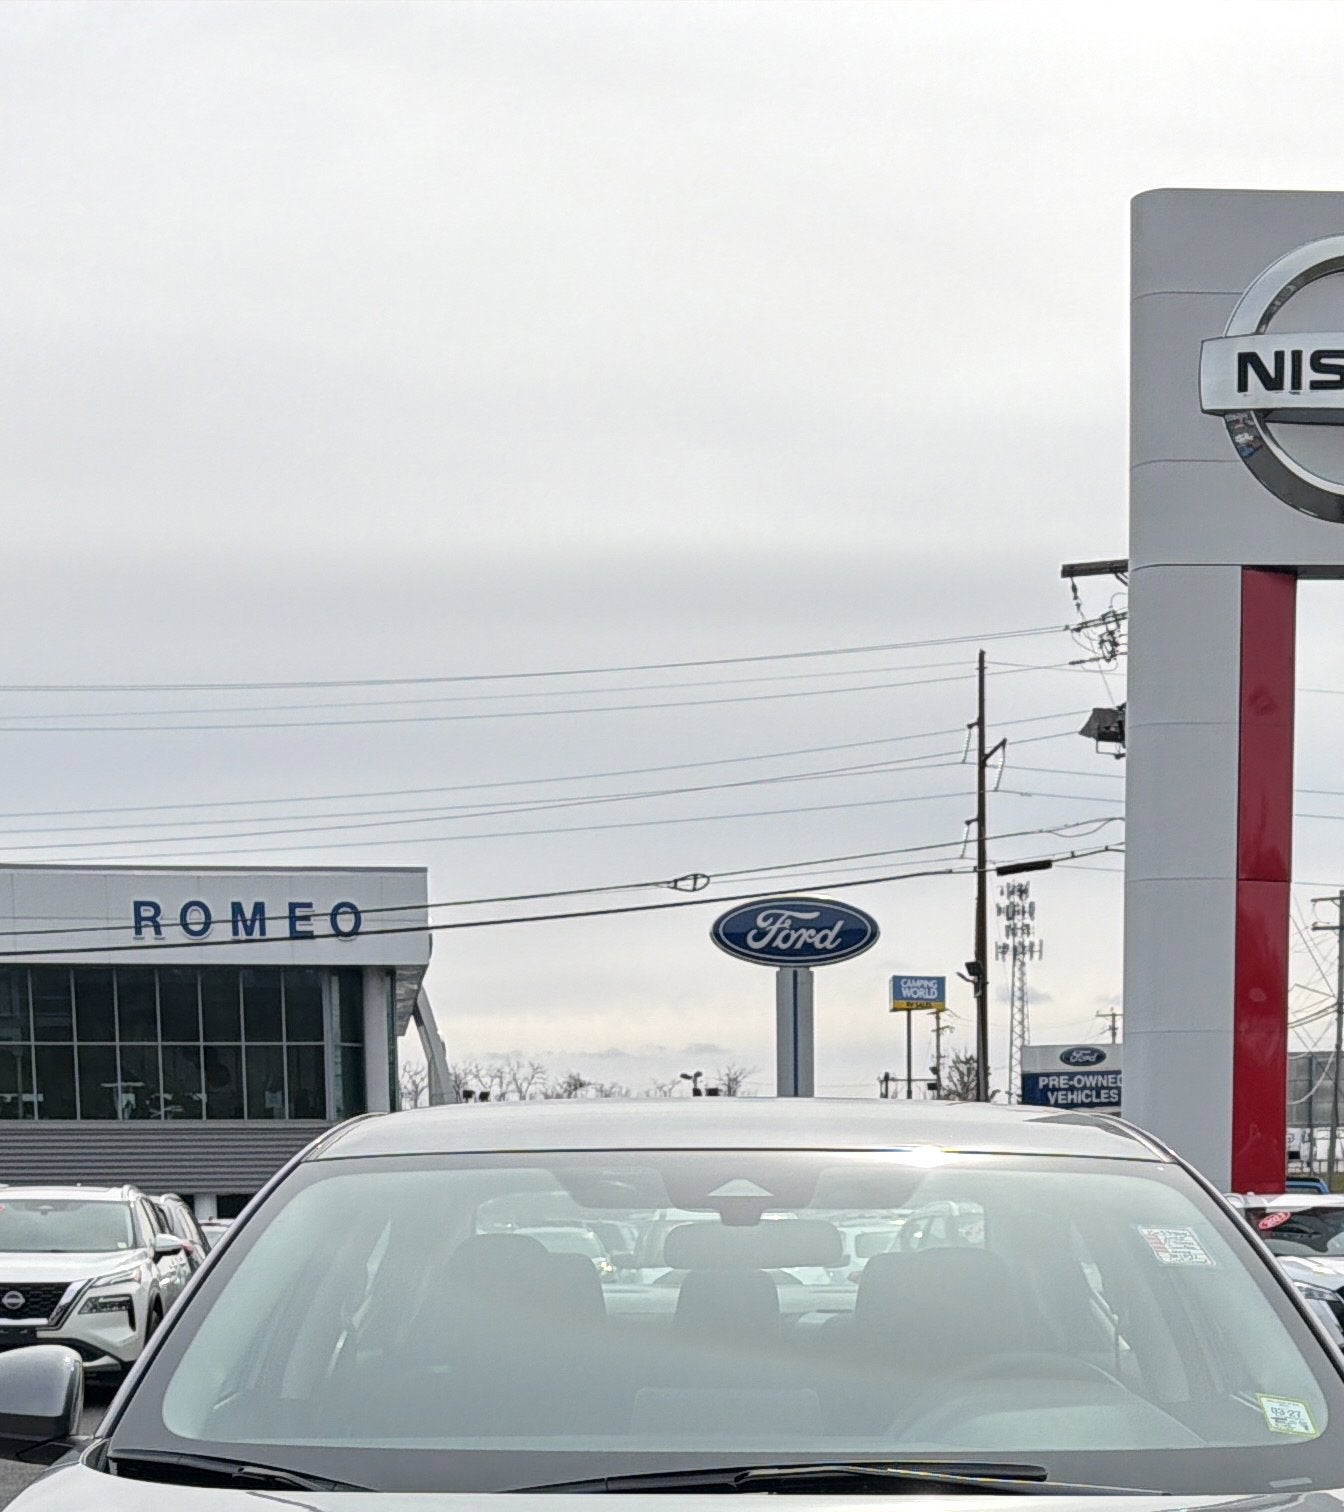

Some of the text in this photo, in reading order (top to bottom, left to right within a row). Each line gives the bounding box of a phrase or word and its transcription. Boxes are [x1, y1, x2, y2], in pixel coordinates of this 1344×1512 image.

[133, 900, 362, 938] ROMEO
[746, 909, 845, 949] Ford
[900, 979, 938, 989] CAMPING
[901, 988, 938, 999] WORLD
[1069, 1050, 1098, 1063] Ford
[1047, 1089, 1119, 1104] VEHICLES
